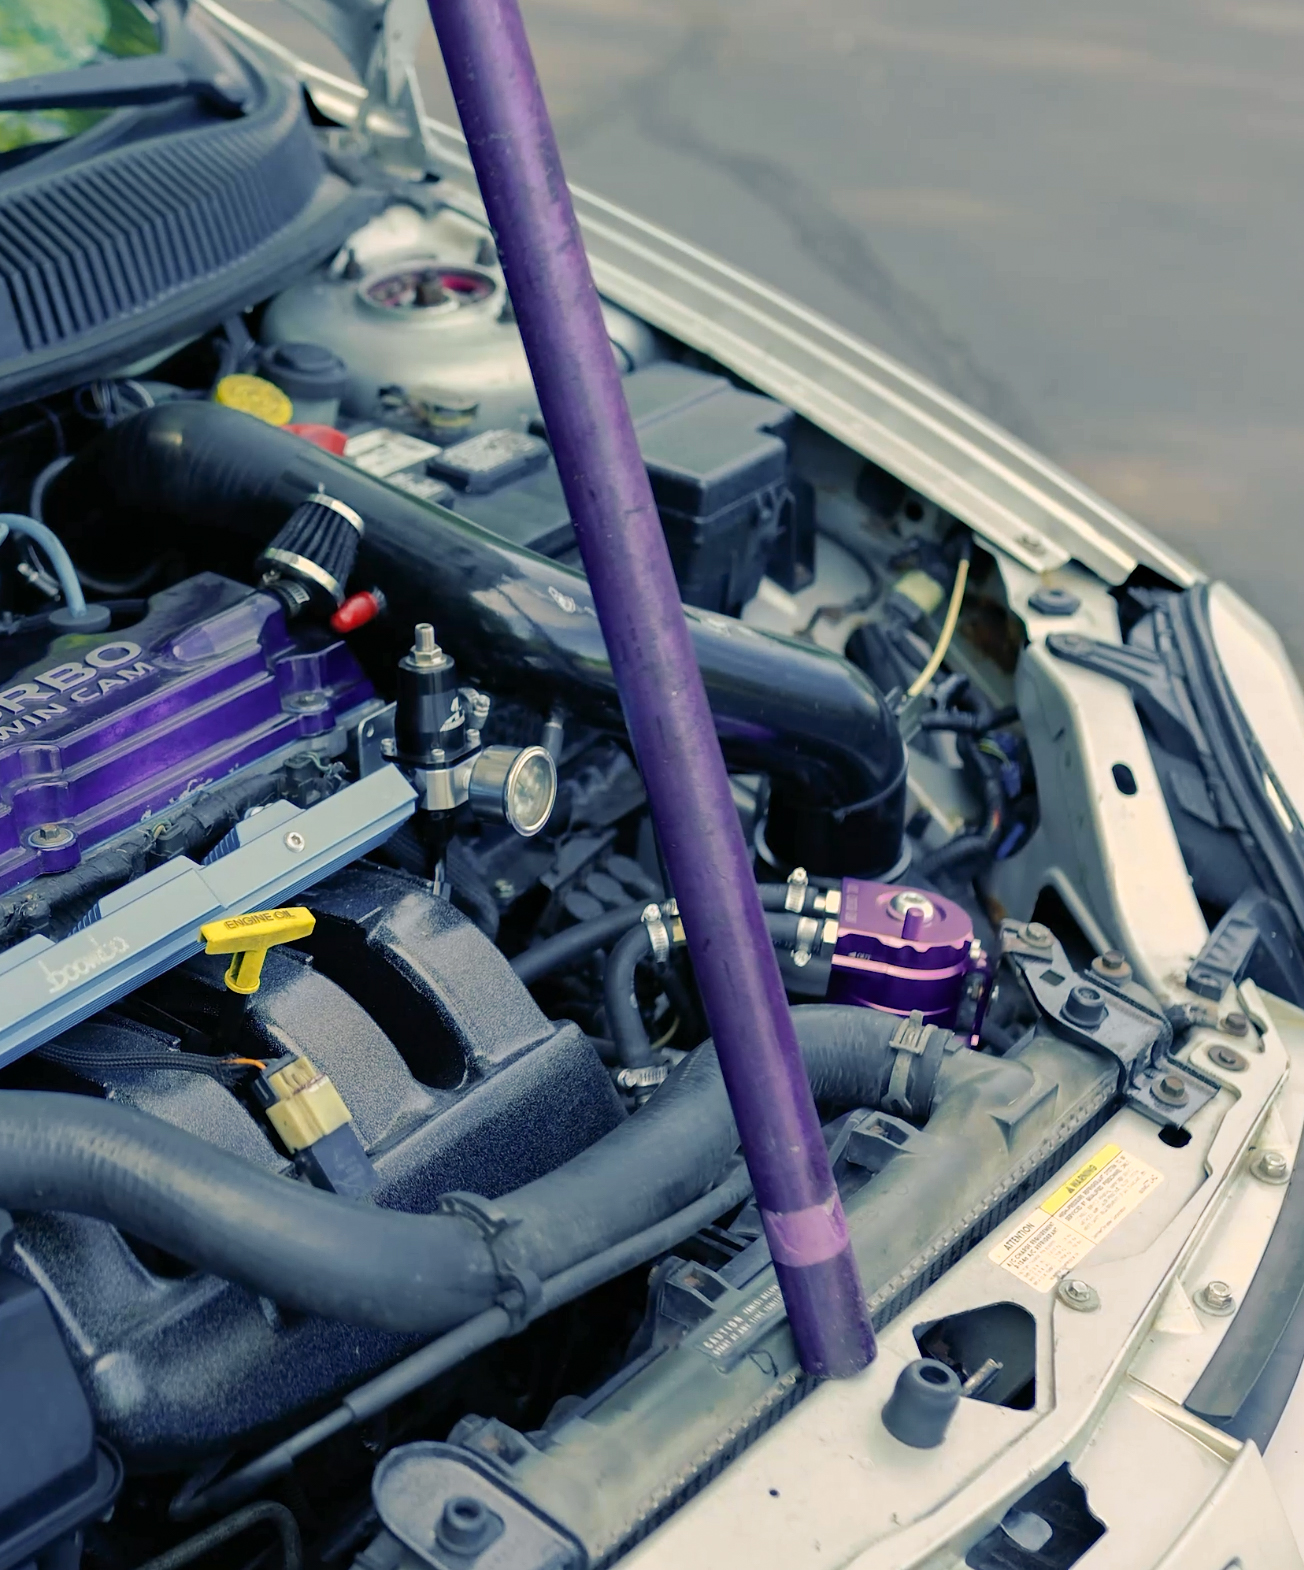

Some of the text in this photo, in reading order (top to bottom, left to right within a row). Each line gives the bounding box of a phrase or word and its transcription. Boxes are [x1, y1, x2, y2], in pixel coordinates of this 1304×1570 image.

[70, 660, 156, 704] CAM
[224, 910, 295, 930] ENGINE OIL
[1004, 1222, 1035, 1251] ATTENTION
[703, 1315, 744, 1349] CAUTION
